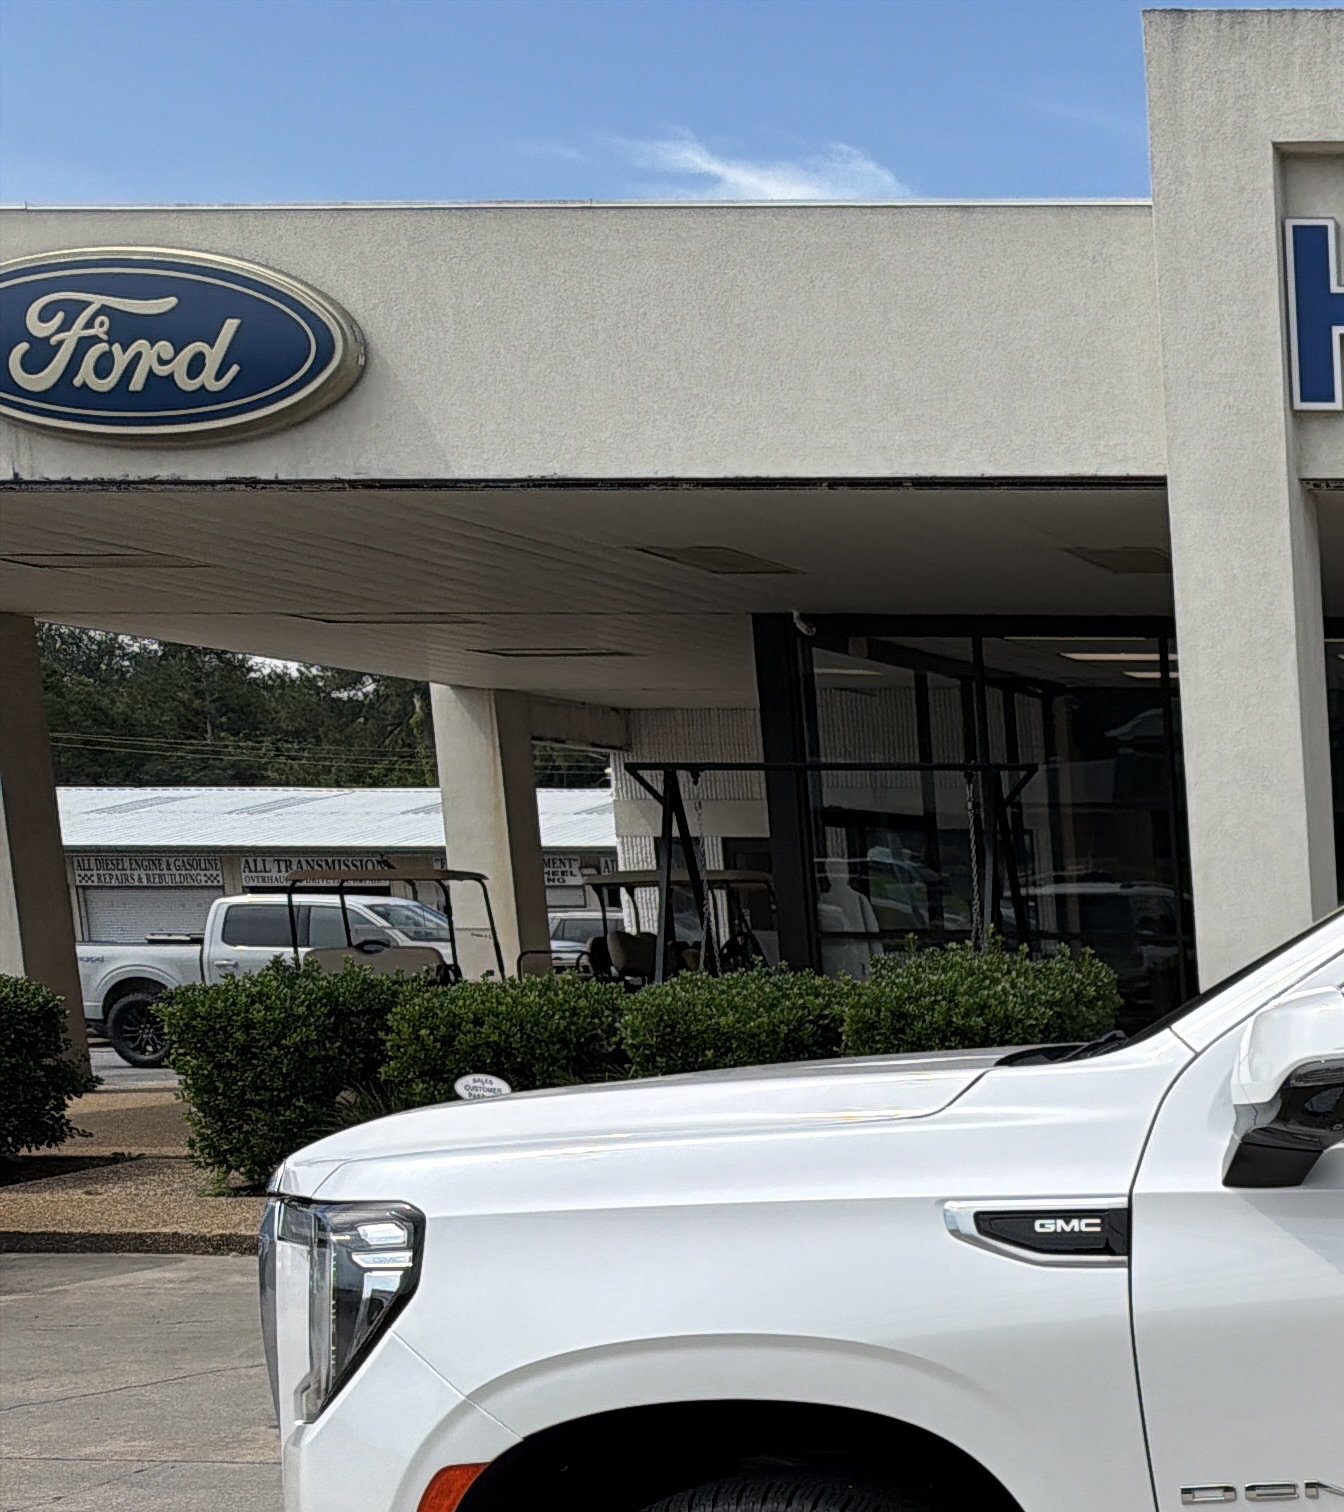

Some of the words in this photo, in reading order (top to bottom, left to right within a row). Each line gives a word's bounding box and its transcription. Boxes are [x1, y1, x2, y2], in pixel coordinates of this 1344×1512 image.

[8, 291, 241, 393] Ford
[76, 858, 94, 871] ALL
[95, 858, 128, 871] DIESEL
[129, 858, 164, 871] ENGINE
[166, 859, 172, 871] &
[173, 858, 221, 871] GASOLINE
[242, 858, 271, 873] ALL
[96, 873, 136, 884] REPAIRS
[137, 873, 144, 884] &
[145, 873, 203, 885] REBUILDING
[464, 1084, 503, 1096] CUSTOMER
[1034, 1218, 1102, 1232] GMC
